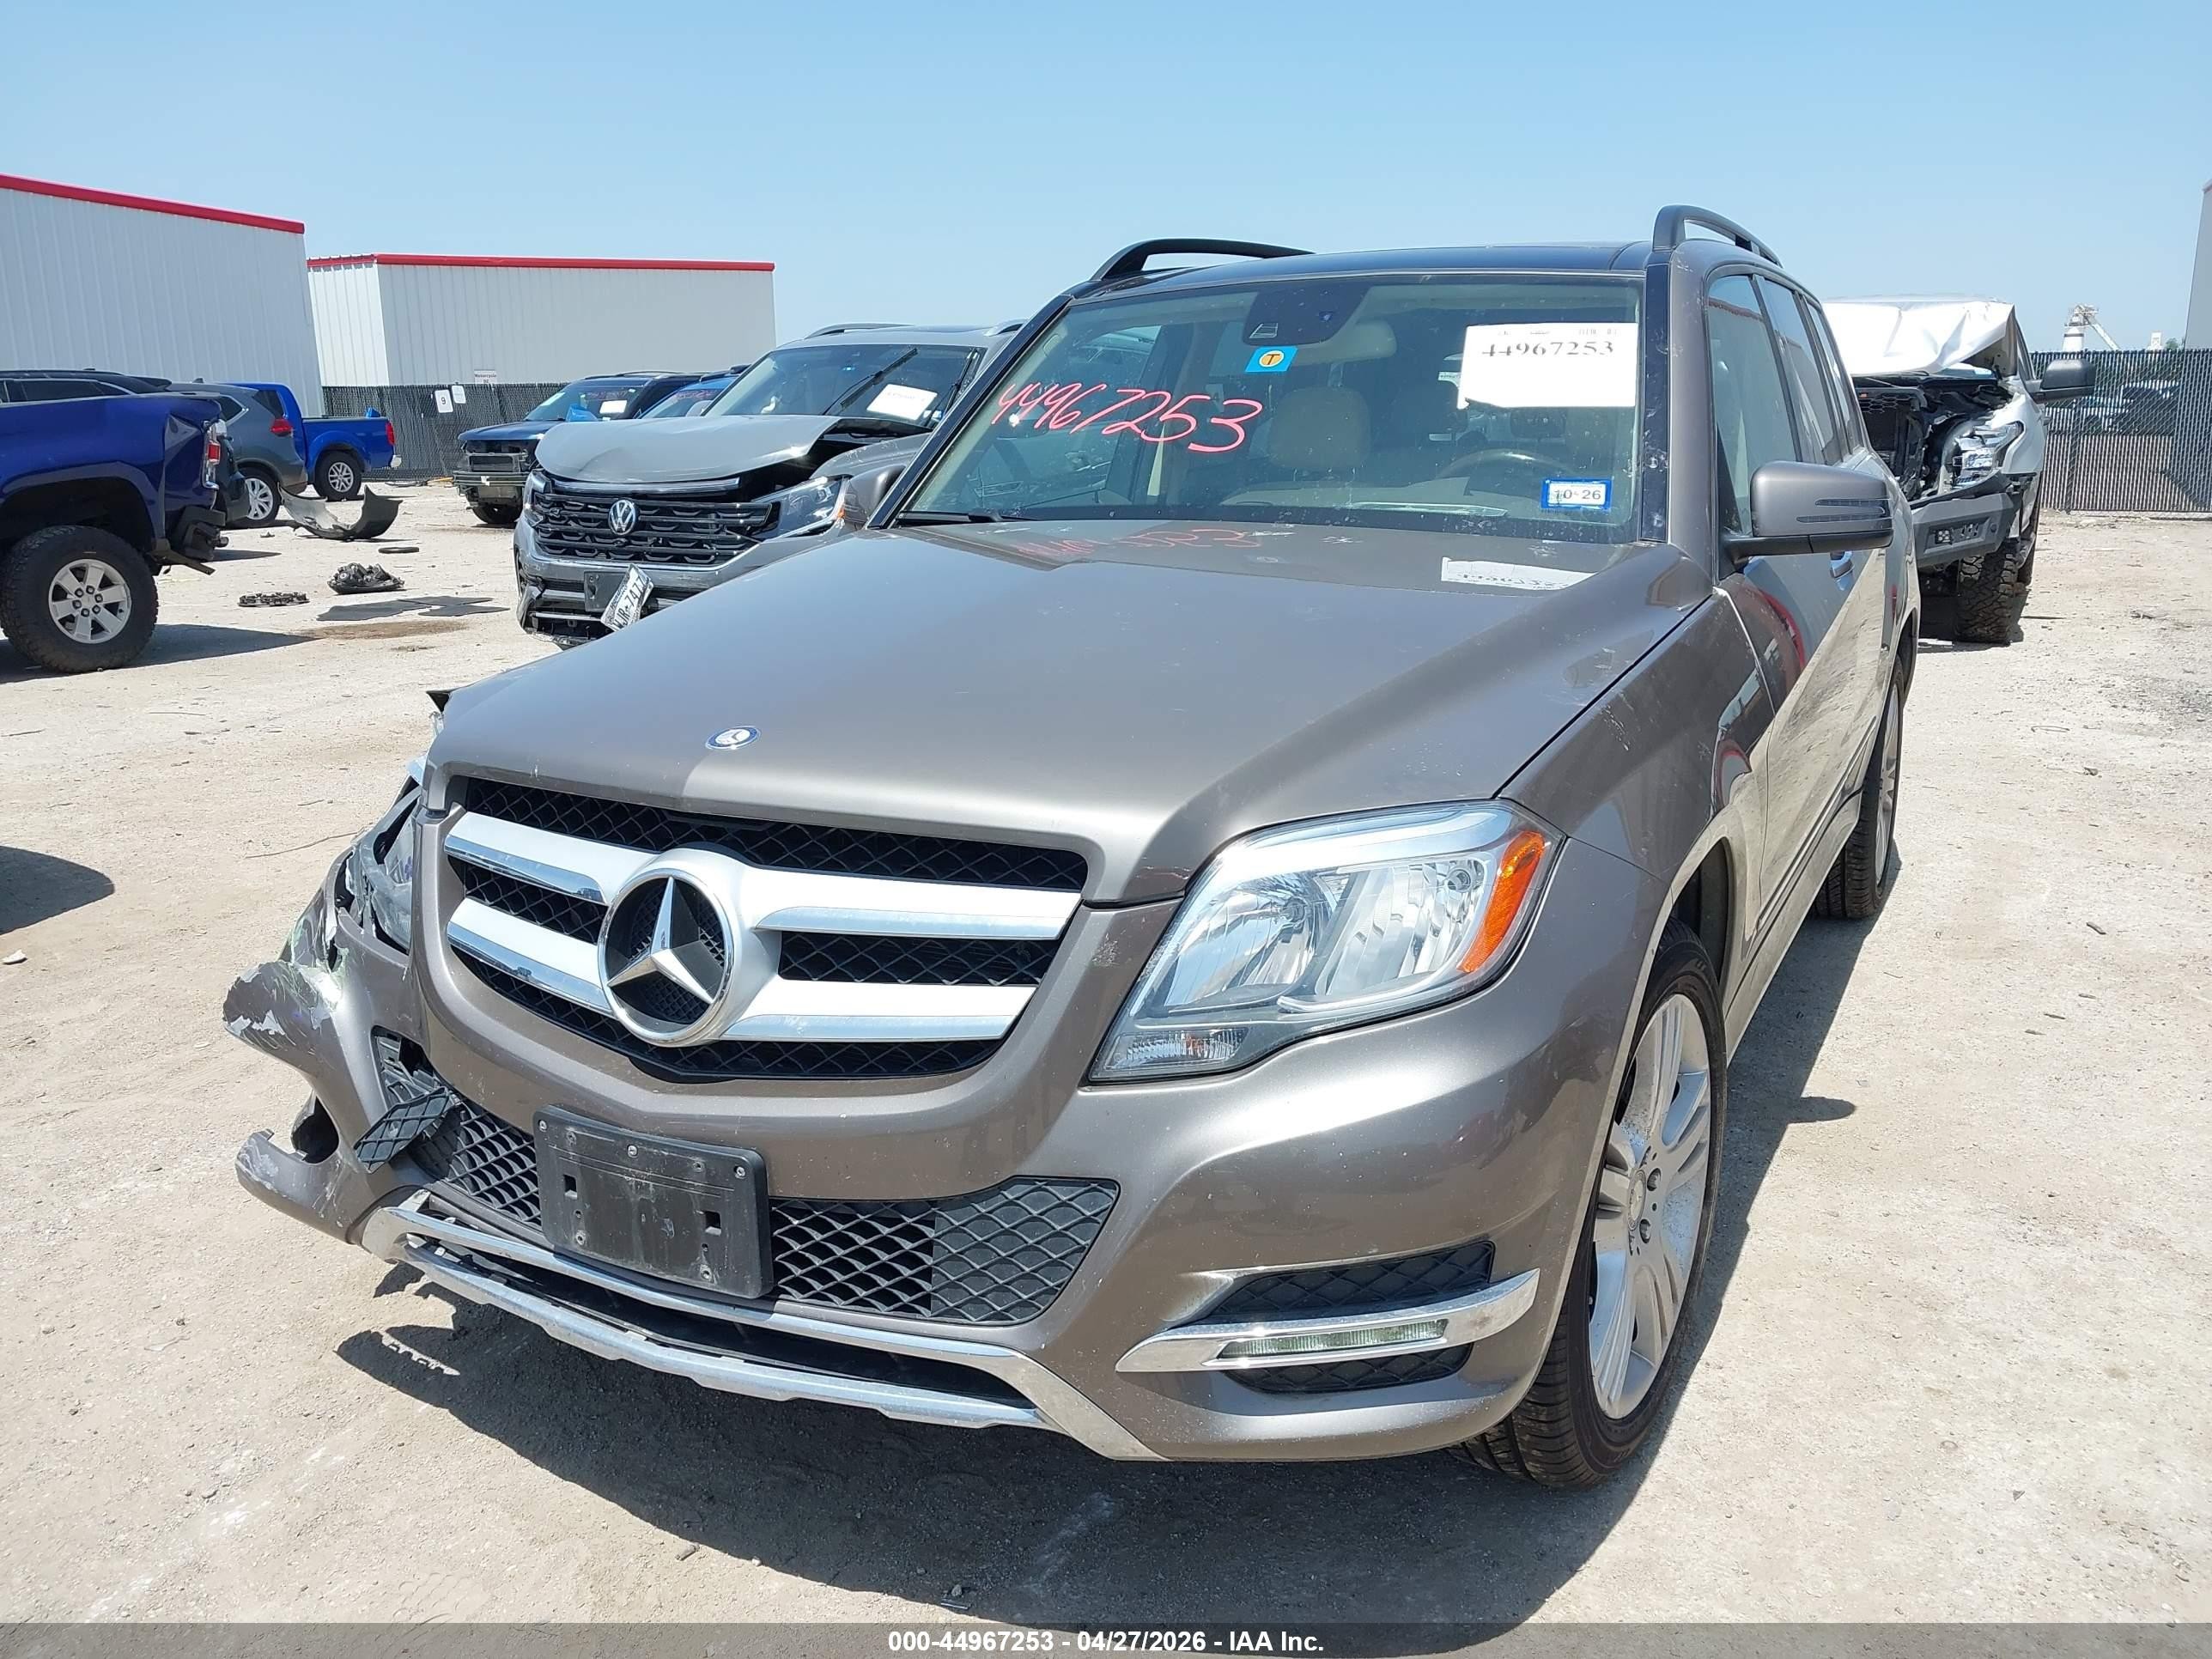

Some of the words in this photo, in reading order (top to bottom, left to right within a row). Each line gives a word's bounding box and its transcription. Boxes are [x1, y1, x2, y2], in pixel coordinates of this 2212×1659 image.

[1482, 341, 1613, 356] 44967253
[1267, 353, 1280, 365] T
[441, 397, 447, 405] 9
[991, 382, 1263, 453] 44967253
